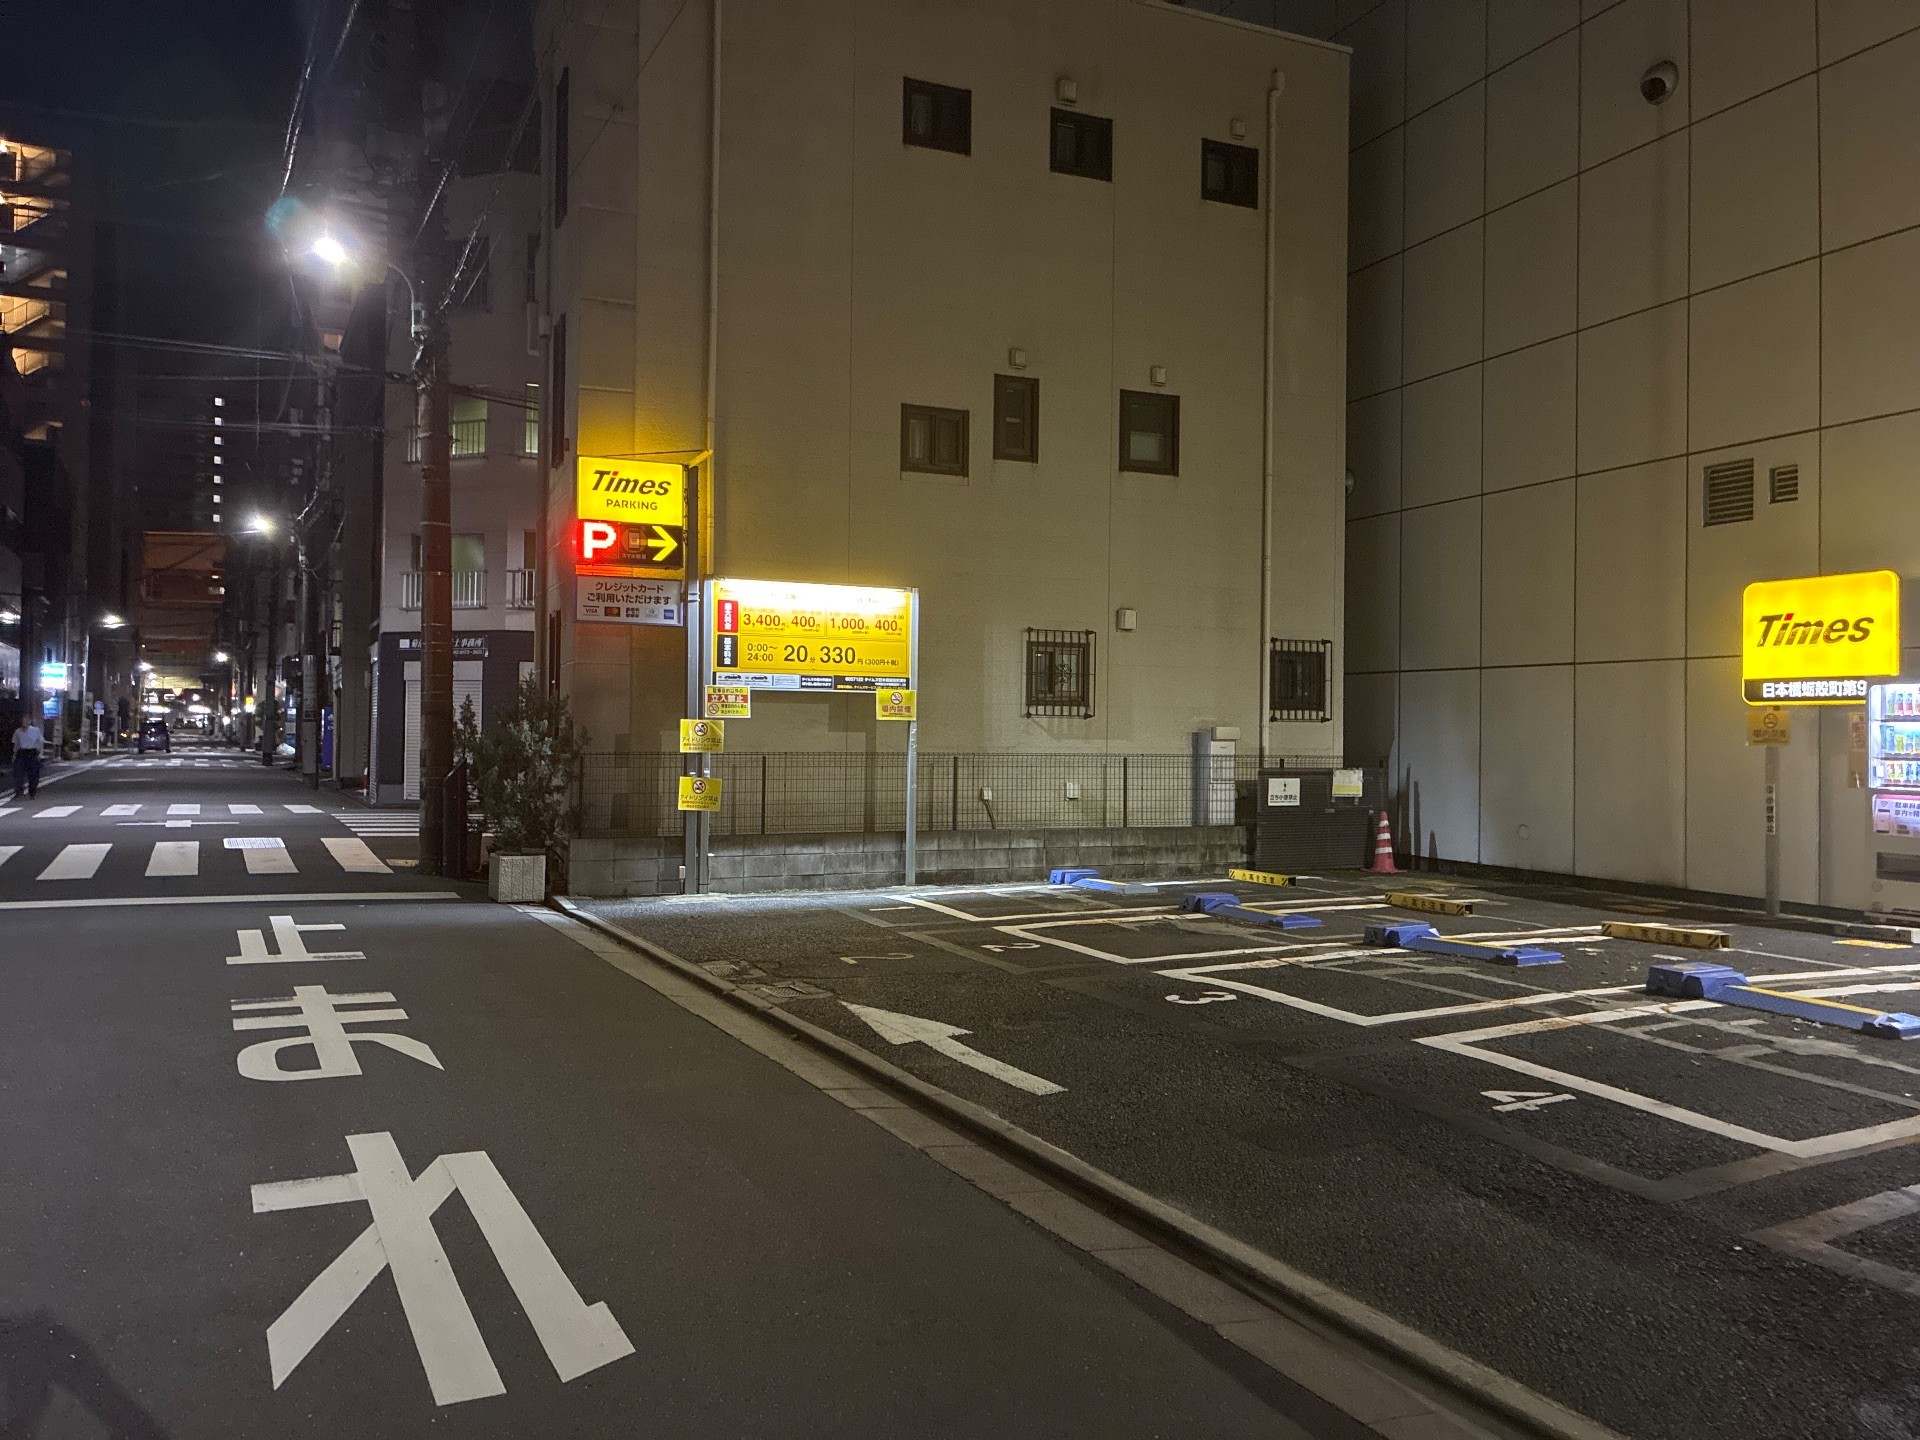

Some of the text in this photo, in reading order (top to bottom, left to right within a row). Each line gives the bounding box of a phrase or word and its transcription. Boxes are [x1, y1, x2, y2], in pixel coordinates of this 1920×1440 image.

[592, 470, 672, 496] Times
[606, 499, 658, 510] PARKING
[583, 522, 617, 559] P
[595, 582, 664, 593] クレジットカード
[587, 592, 671, 605] ご利用いただけます
[1756, 612, 1875, 648] Times
[747, 653, 774, 661] 24:00
[711, 695, 745, 703] 立入禁止
[1480, 1088, 1579, 1113] 4
